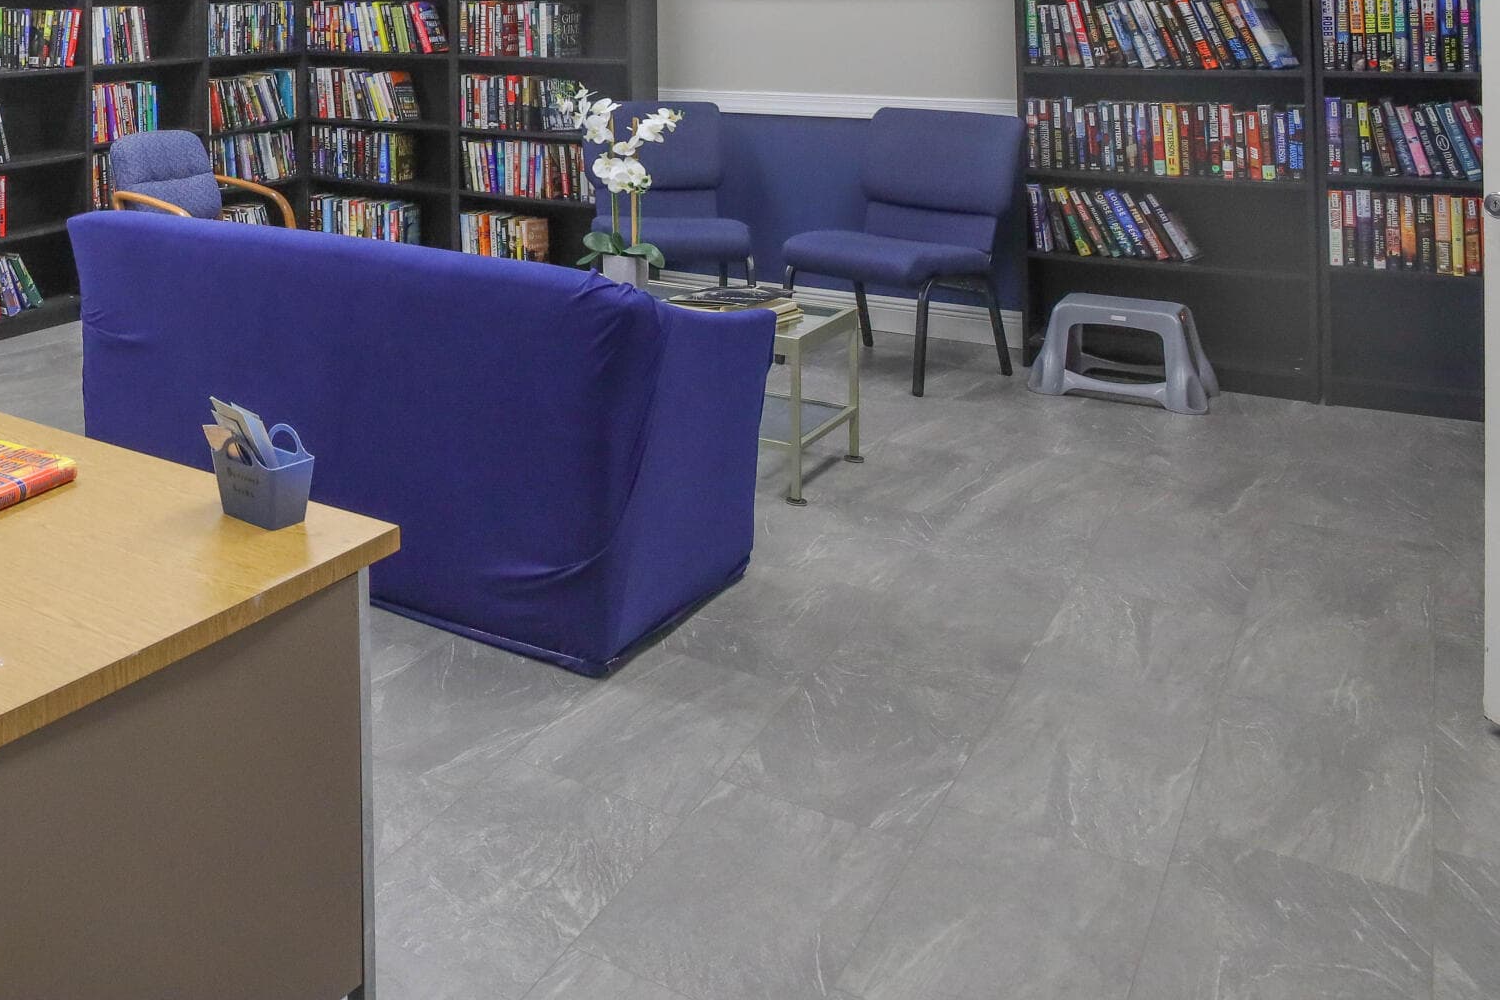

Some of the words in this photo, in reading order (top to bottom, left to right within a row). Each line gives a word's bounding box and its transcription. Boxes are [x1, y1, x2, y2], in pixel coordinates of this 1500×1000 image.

[1185, 16, 1204, 41] PATTERSON
[1323, 16, 1333, 36] ROBB
[1366, 14, 1375, 34] ROBB
[1093, 46, 1103, 57] 21
[1113, 121, 1123, 149] PATTERSON
[1166, 124, 1174, 156] PATTERSON
[1277, 134, 1285, 163] PATTERSON
[1095, 191, 1112, 215] LOUISE
[1111, 222, 1127, 244] PENNY
[1108, 192, 1126, 217] LOUISE
[1125, 223, 1143, 246] PENNY
